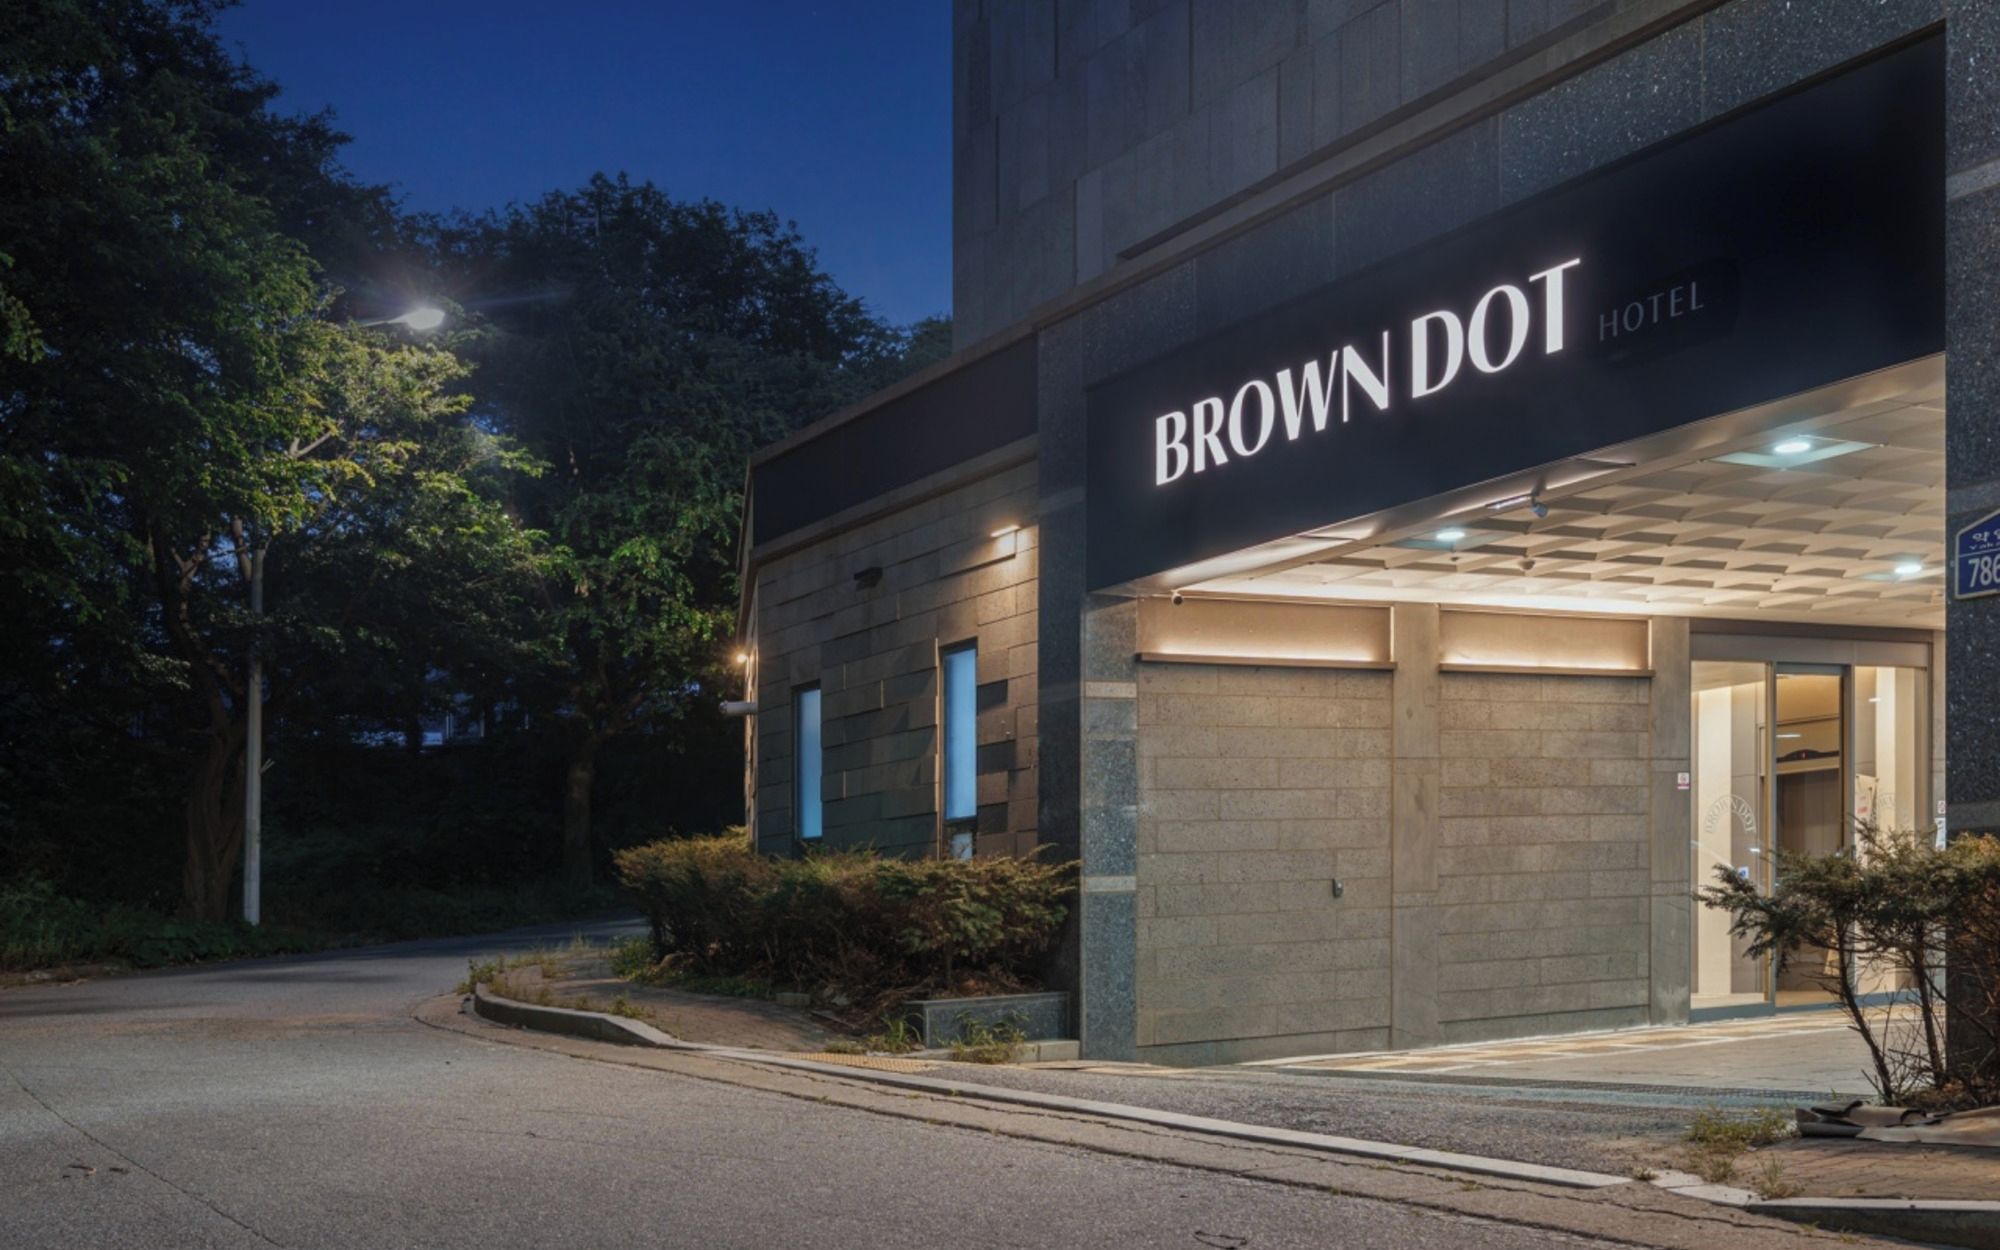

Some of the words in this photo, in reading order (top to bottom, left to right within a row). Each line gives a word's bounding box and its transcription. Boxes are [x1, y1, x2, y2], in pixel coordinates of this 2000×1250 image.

[1155, 330, 1389, 487] BROWN
[1411, 257, 1581, 399] DOT
[1600, 281, 1705, 342] HOTEL
